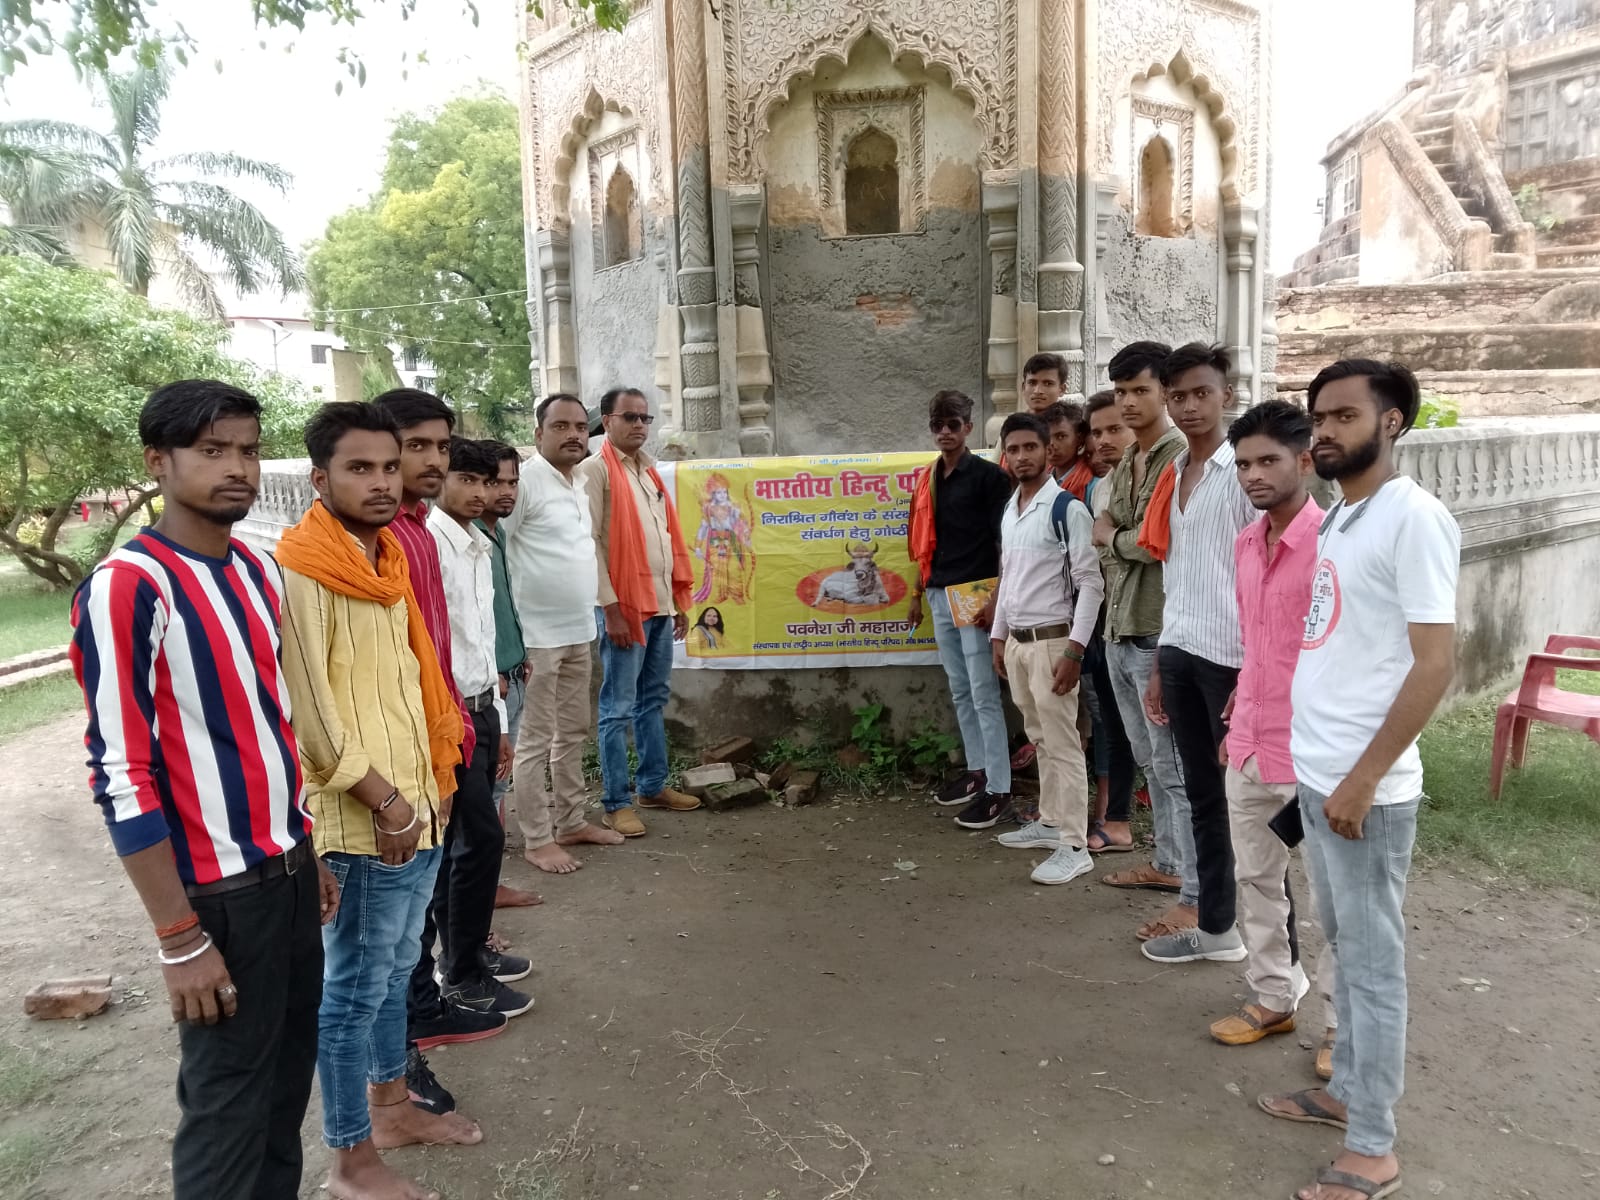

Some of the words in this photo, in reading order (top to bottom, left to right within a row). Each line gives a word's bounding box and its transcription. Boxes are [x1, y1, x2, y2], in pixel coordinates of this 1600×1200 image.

[755, 472, 834, 500] भारतीय
[840, 470, 892, 503] हिन्दू
[761, 511, 816, 525] निराश्रित
[863, 508, 877, 521] के
[801, 526, 844, 540] संवर्धन
[849, 526, 871, 542] हेतु
[786, 620, 832, 636] पवनेश
[836, 618, 855, 634] जी
[859, 621, 912, 634] महाराज
